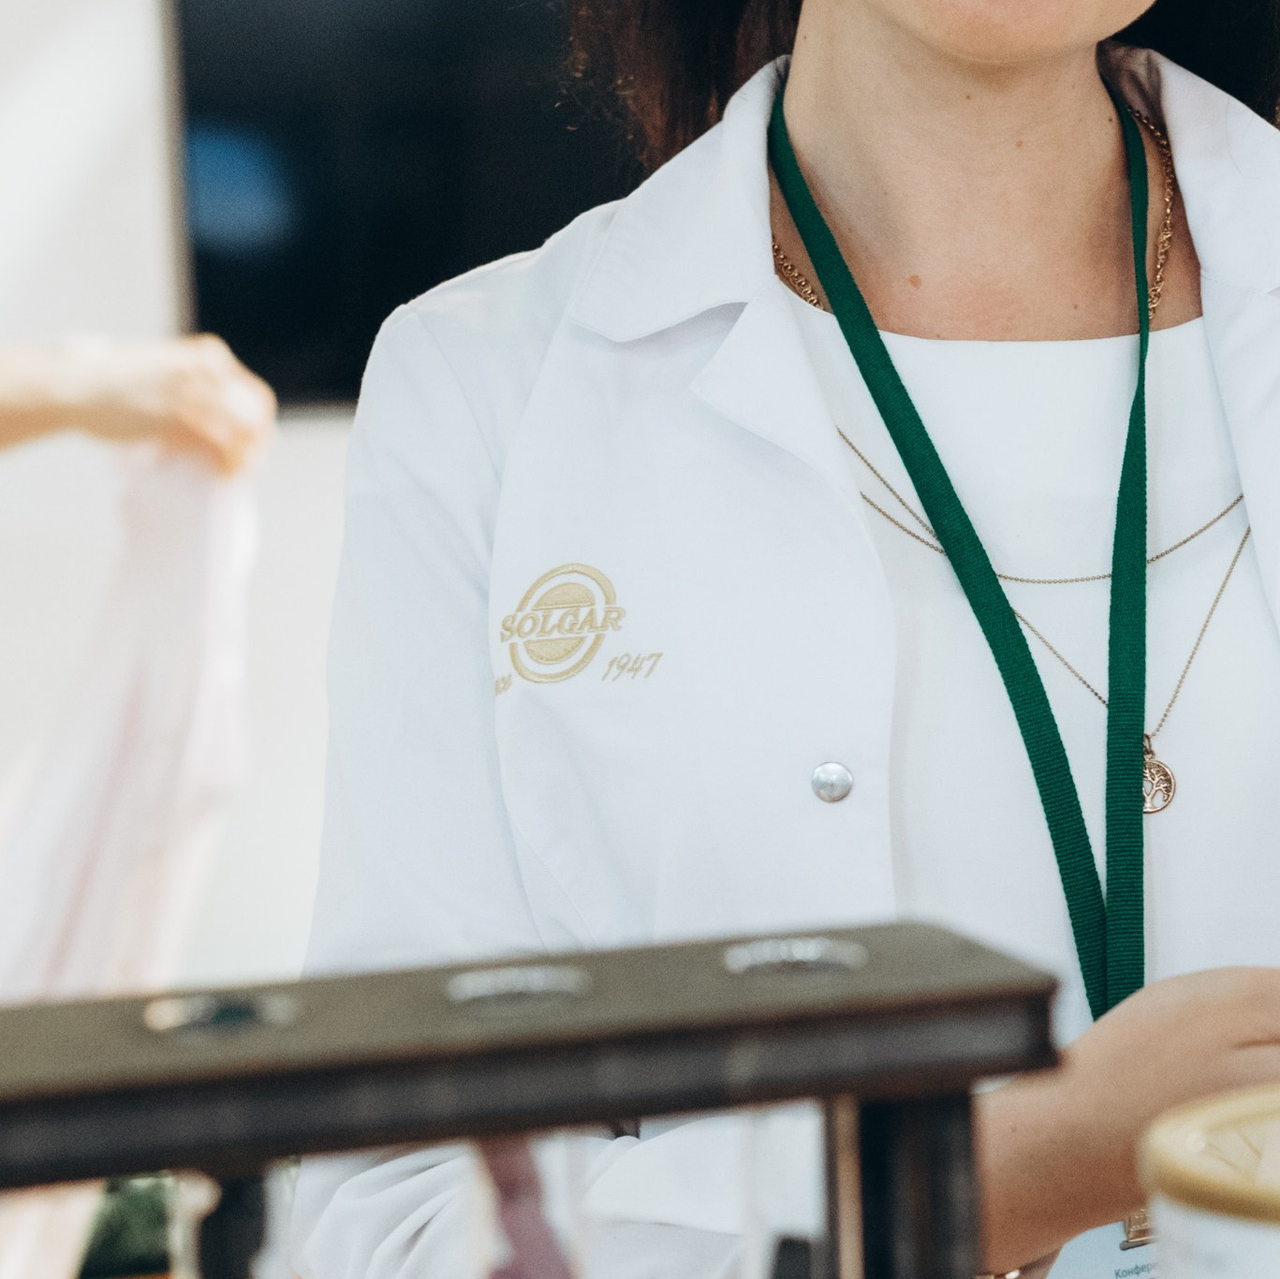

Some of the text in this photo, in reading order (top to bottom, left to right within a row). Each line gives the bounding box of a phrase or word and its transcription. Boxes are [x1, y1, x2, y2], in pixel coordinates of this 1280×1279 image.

[500, 606, 627, 643] SOLGAR
[602, 652, 663, 682] 1947
[1115, 1262, 1156, 1279] Конфер
